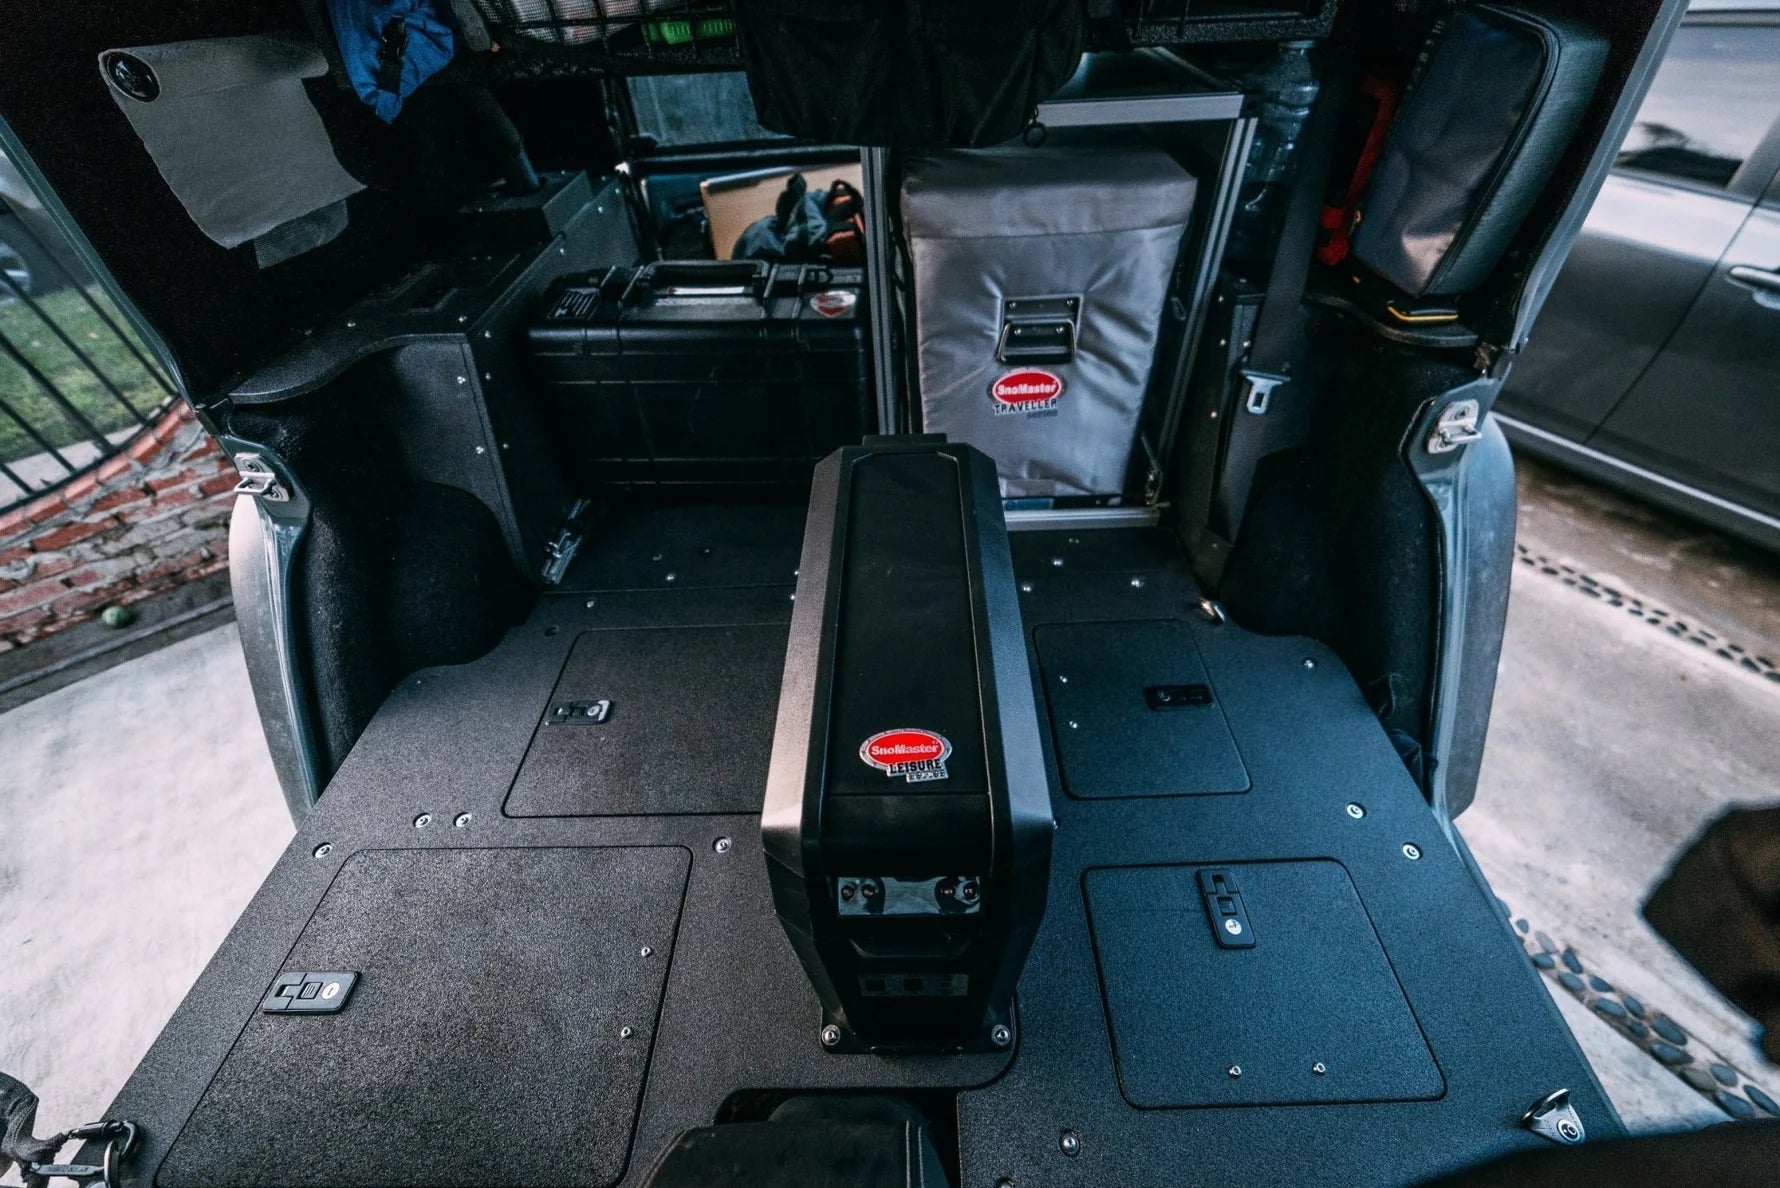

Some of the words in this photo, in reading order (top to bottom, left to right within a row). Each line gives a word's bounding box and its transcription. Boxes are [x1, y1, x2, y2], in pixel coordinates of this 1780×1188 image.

[997, 382, 1057, 396] SnoMaster
[994, 399, 1057, 414] TRAVELLER
[871, 744, 940, 756] SnoMaster
[889, 759, 942, 774] LEISURE
